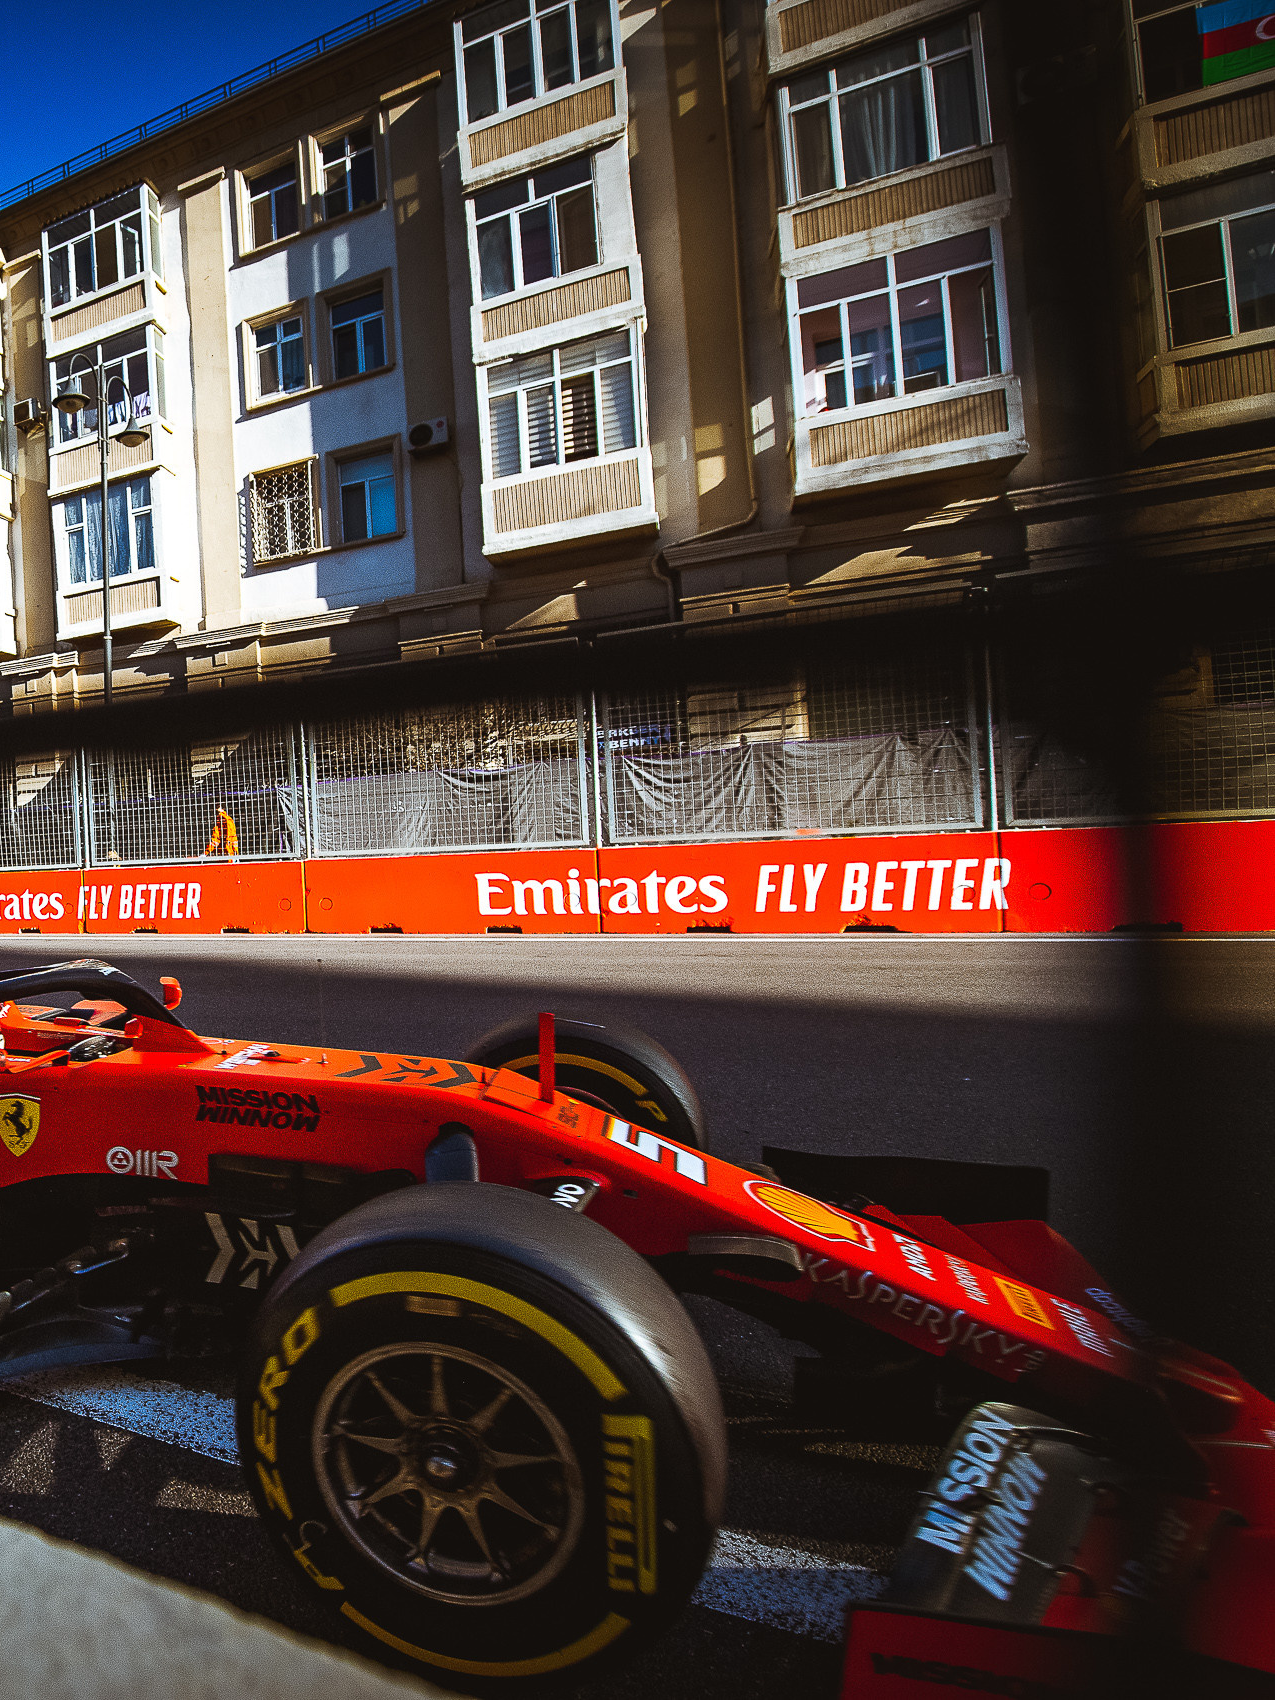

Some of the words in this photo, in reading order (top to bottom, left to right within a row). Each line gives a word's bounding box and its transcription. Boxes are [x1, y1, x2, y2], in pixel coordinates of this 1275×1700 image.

[77, 884, 113, 921] FLY
[118, 881, 202, 920] BETTER
[475, 869, 729, 917] Emirates
[754, 862, 828, 914] FLY
[841, 856, 1013, 912] BETTER
[195, 1085, 321, 1114] MISSION
[195, 1105, 321, 1133] WINNOW
[608, 1116, 708, 1187] 5
[802, 1252, 1028, 1357] KASPERSKY
[253, 1306, 322, 1521] ZERO
[601, 1414, 656, 1595] PIRELLI
[914, 1405, 1016, 1555] MISSION
[963, 1452, 1048, 1602] WINNOW
